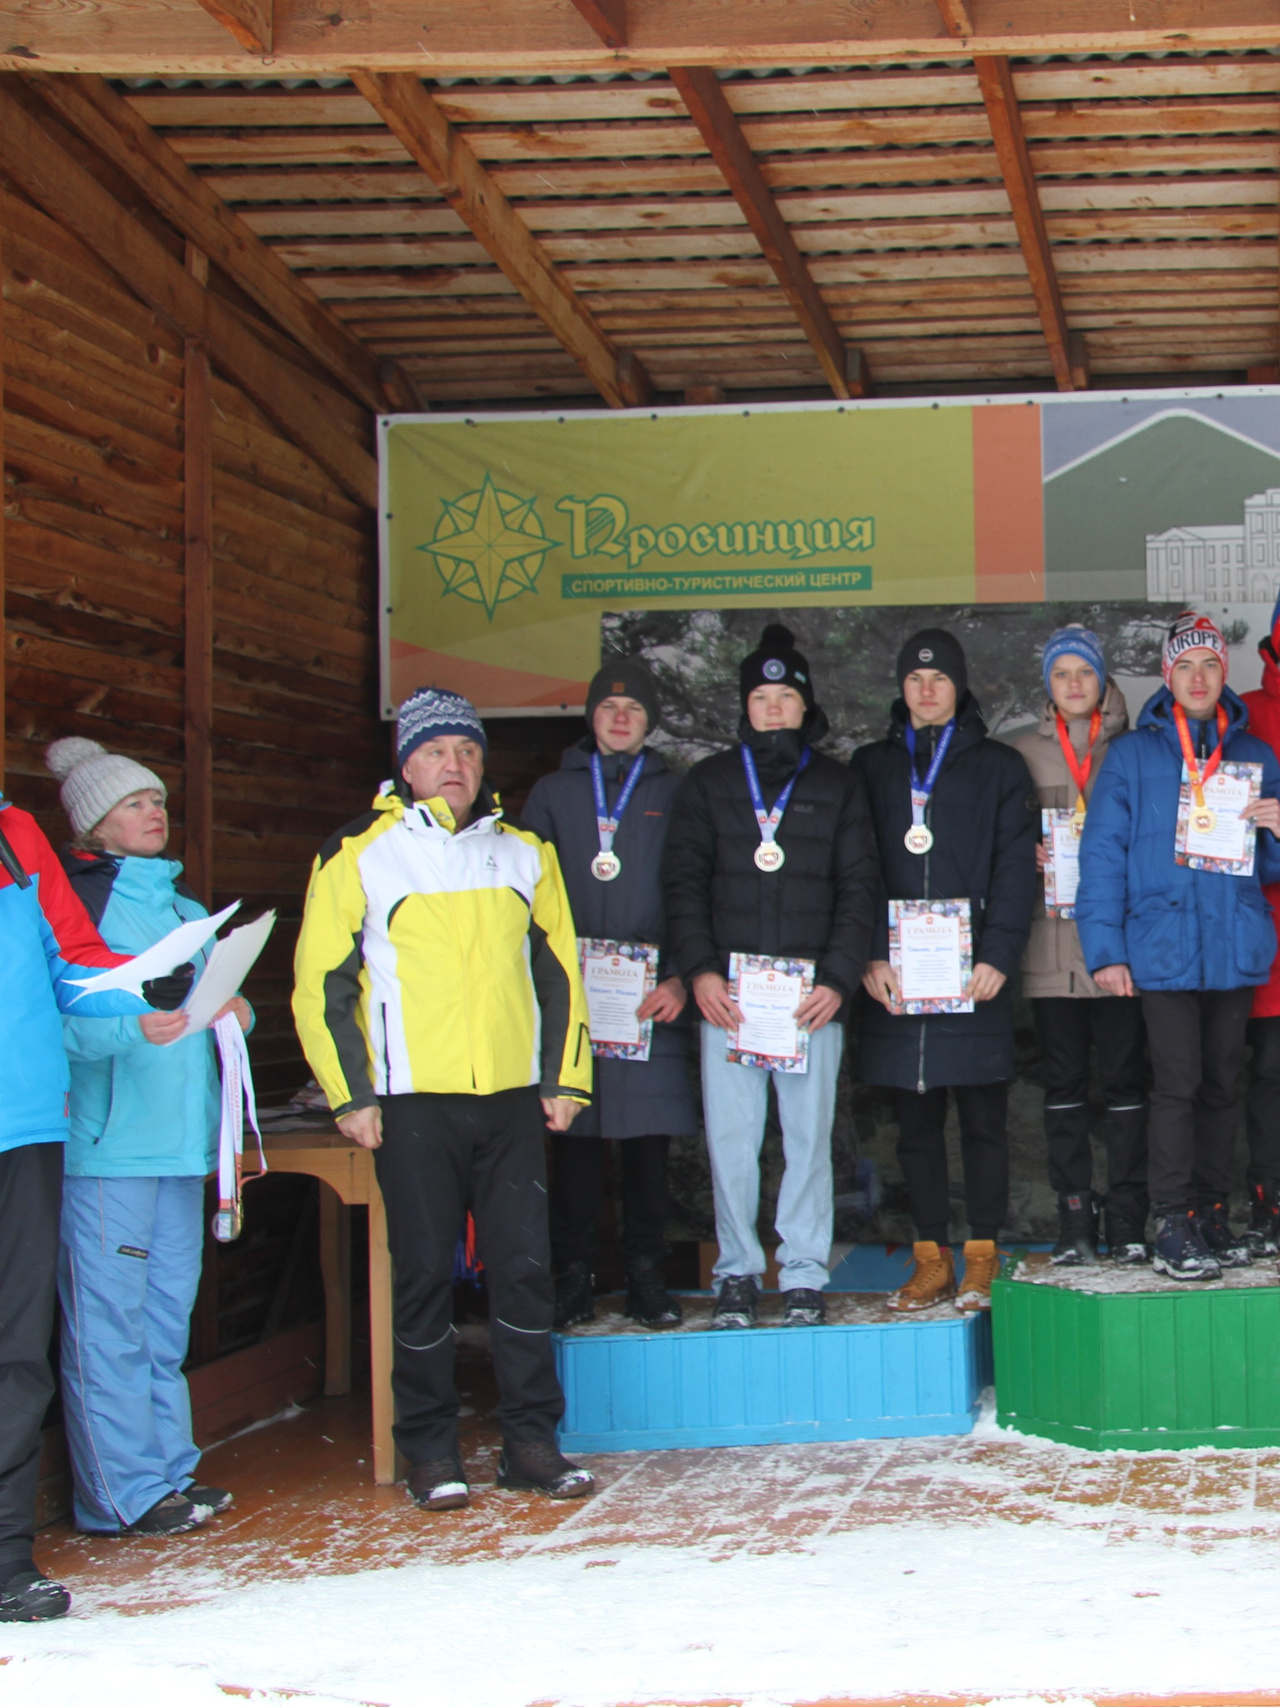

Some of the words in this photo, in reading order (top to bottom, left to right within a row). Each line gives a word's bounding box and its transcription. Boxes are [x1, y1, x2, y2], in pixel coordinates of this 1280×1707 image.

[555, 494, 875, 570] Провинция
[571, 572, 805, 593] СПОРТИВНО-ТУРИСТИЧЕСКИЙ
[809, 571, 862, 588] ЦЕНТР
[1168, 630, 1219, 661] EUROPE
